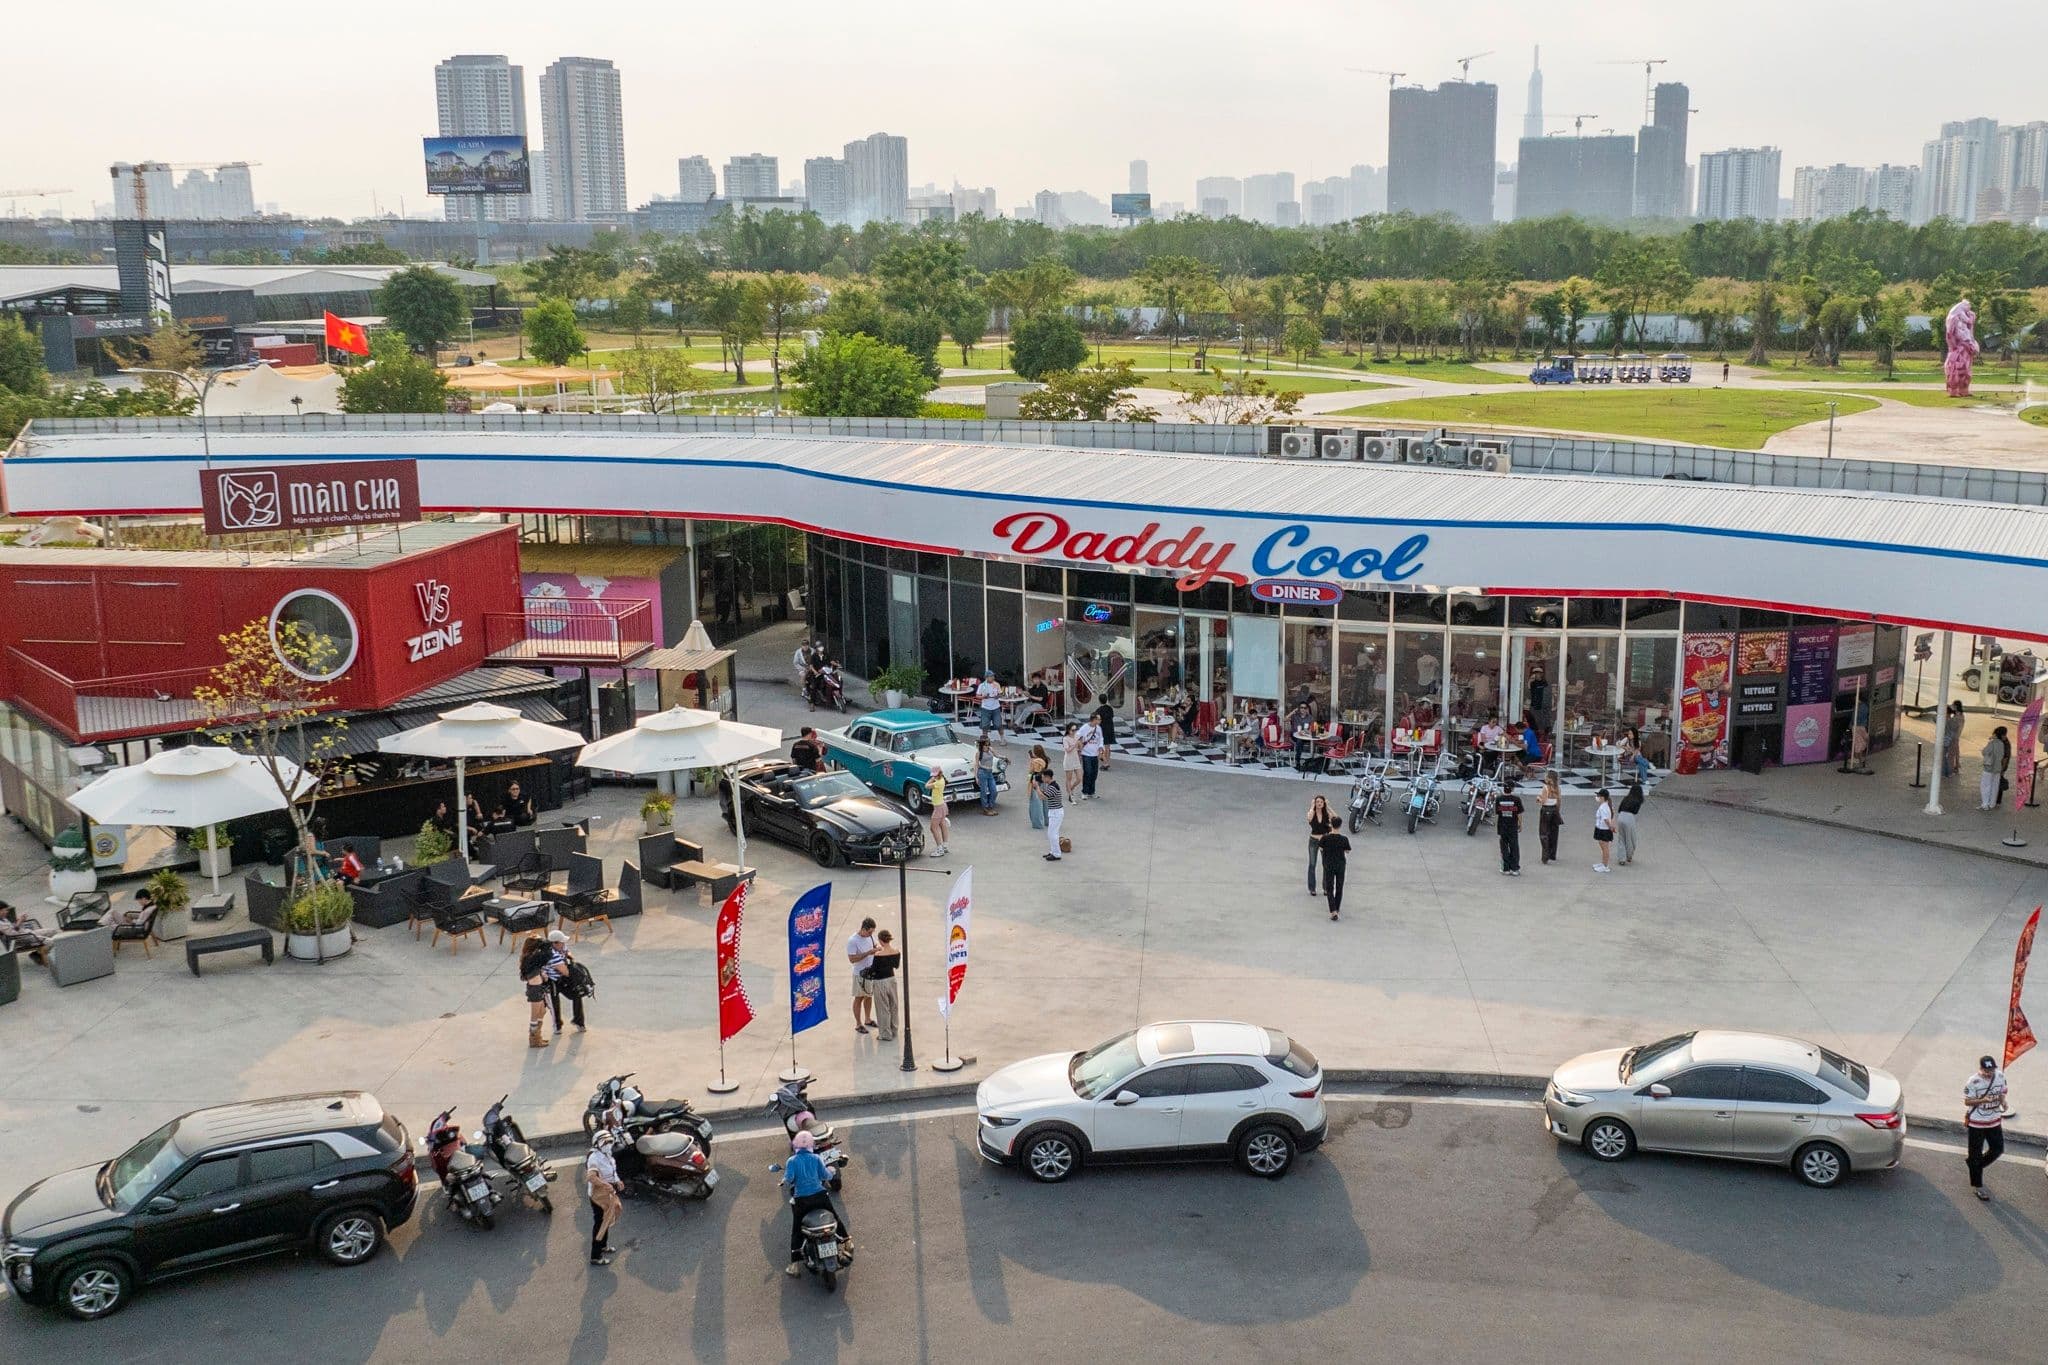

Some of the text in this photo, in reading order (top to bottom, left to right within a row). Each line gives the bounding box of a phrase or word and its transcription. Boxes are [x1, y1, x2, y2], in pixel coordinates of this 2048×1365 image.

[355, 477, 400, 511] CHA
[991, 511, 1430, 592] Daddy Cool
[1272, 585, 1320, 601] DINER
[407, 620, 463, 663] ZONE
[1816, 635, 1830, 643] LIST
